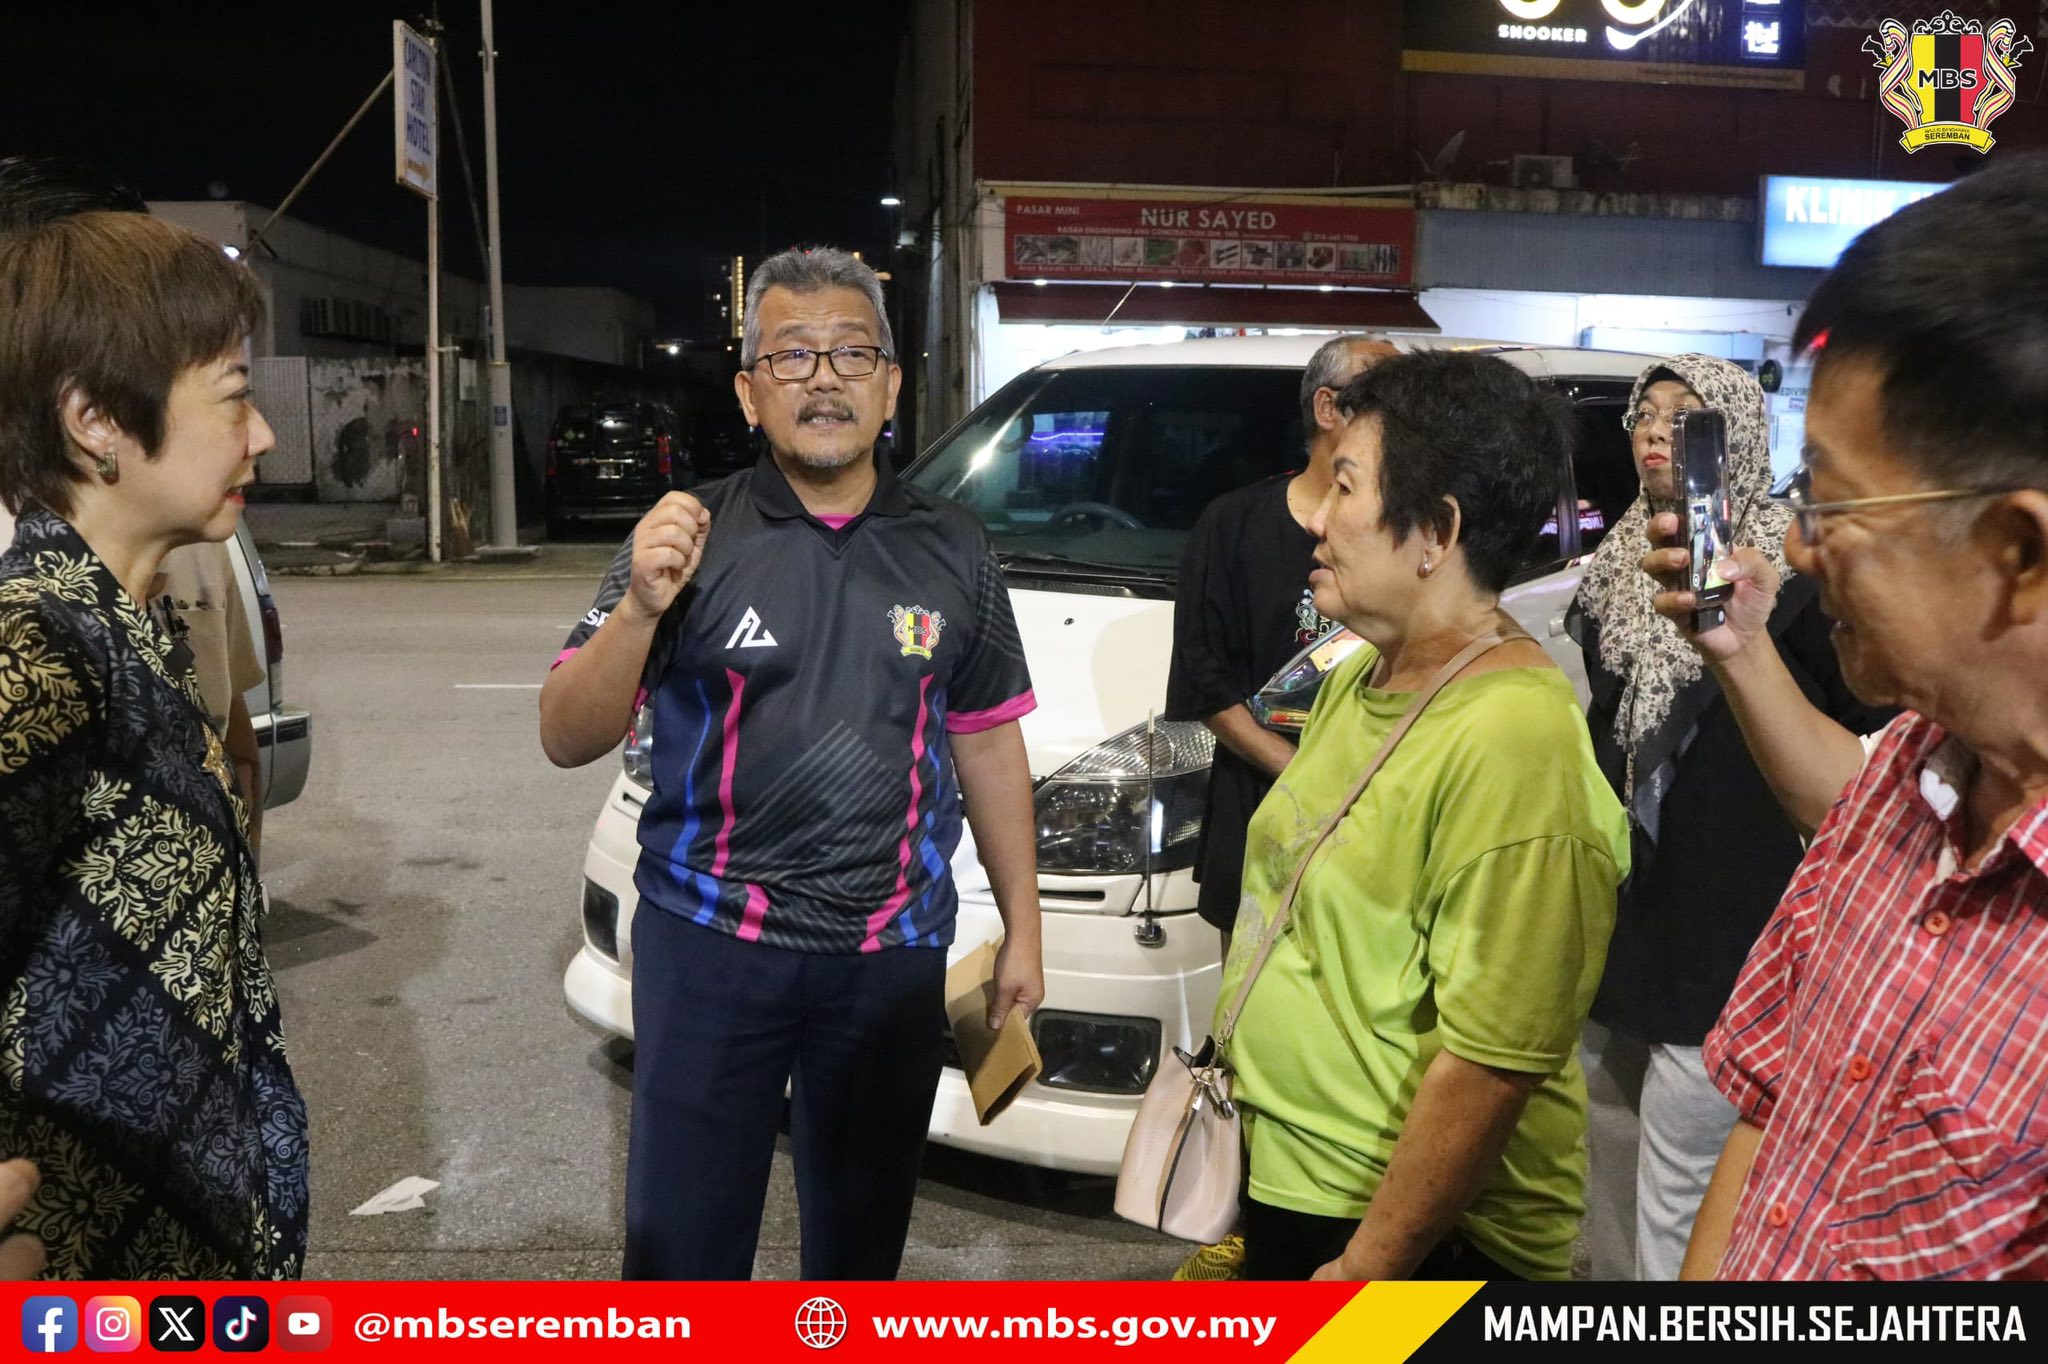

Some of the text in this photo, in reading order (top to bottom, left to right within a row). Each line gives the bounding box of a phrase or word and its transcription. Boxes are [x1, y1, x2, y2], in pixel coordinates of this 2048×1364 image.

[1497, 24, 1588, 43] SNOOKER
[1016, 205, 1080, 215] PASAR MINI
[1198, 210, 1276, 229] SAYED
